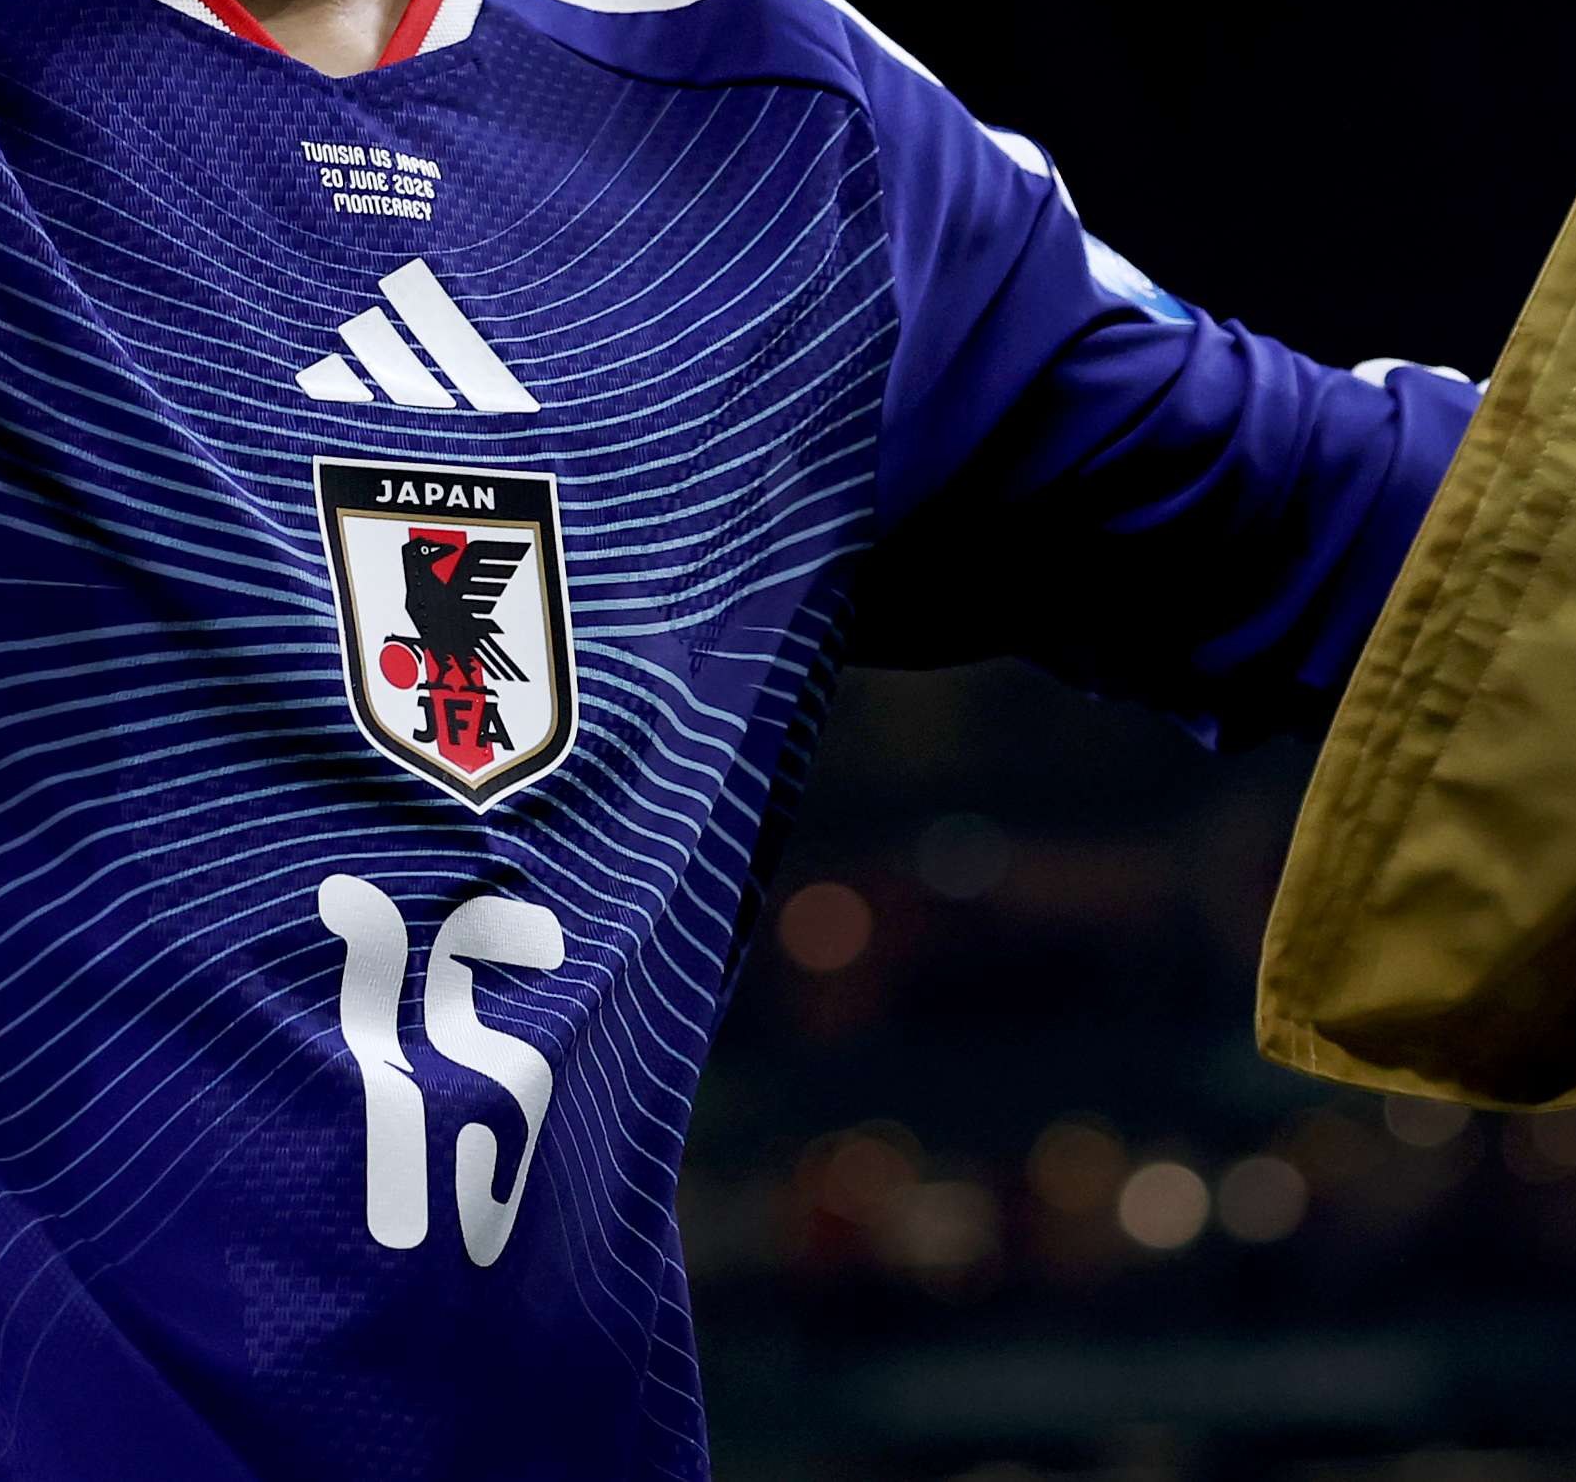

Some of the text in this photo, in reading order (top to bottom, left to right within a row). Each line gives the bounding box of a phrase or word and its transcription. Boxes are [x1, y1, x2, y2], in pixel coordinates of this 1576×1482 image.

[300, 141, 366, 167] TUNISIA
[395, 152, 441, 180] JAPAN
[320, 167, 435, 199] 20 JUNE 2026
[333, 192, 432, 222] MONTERREY
[375, 479, 496, 510] JAPAN
[412, 695, 515, 751] JFA
[318, 873, 565, 1267] 15
